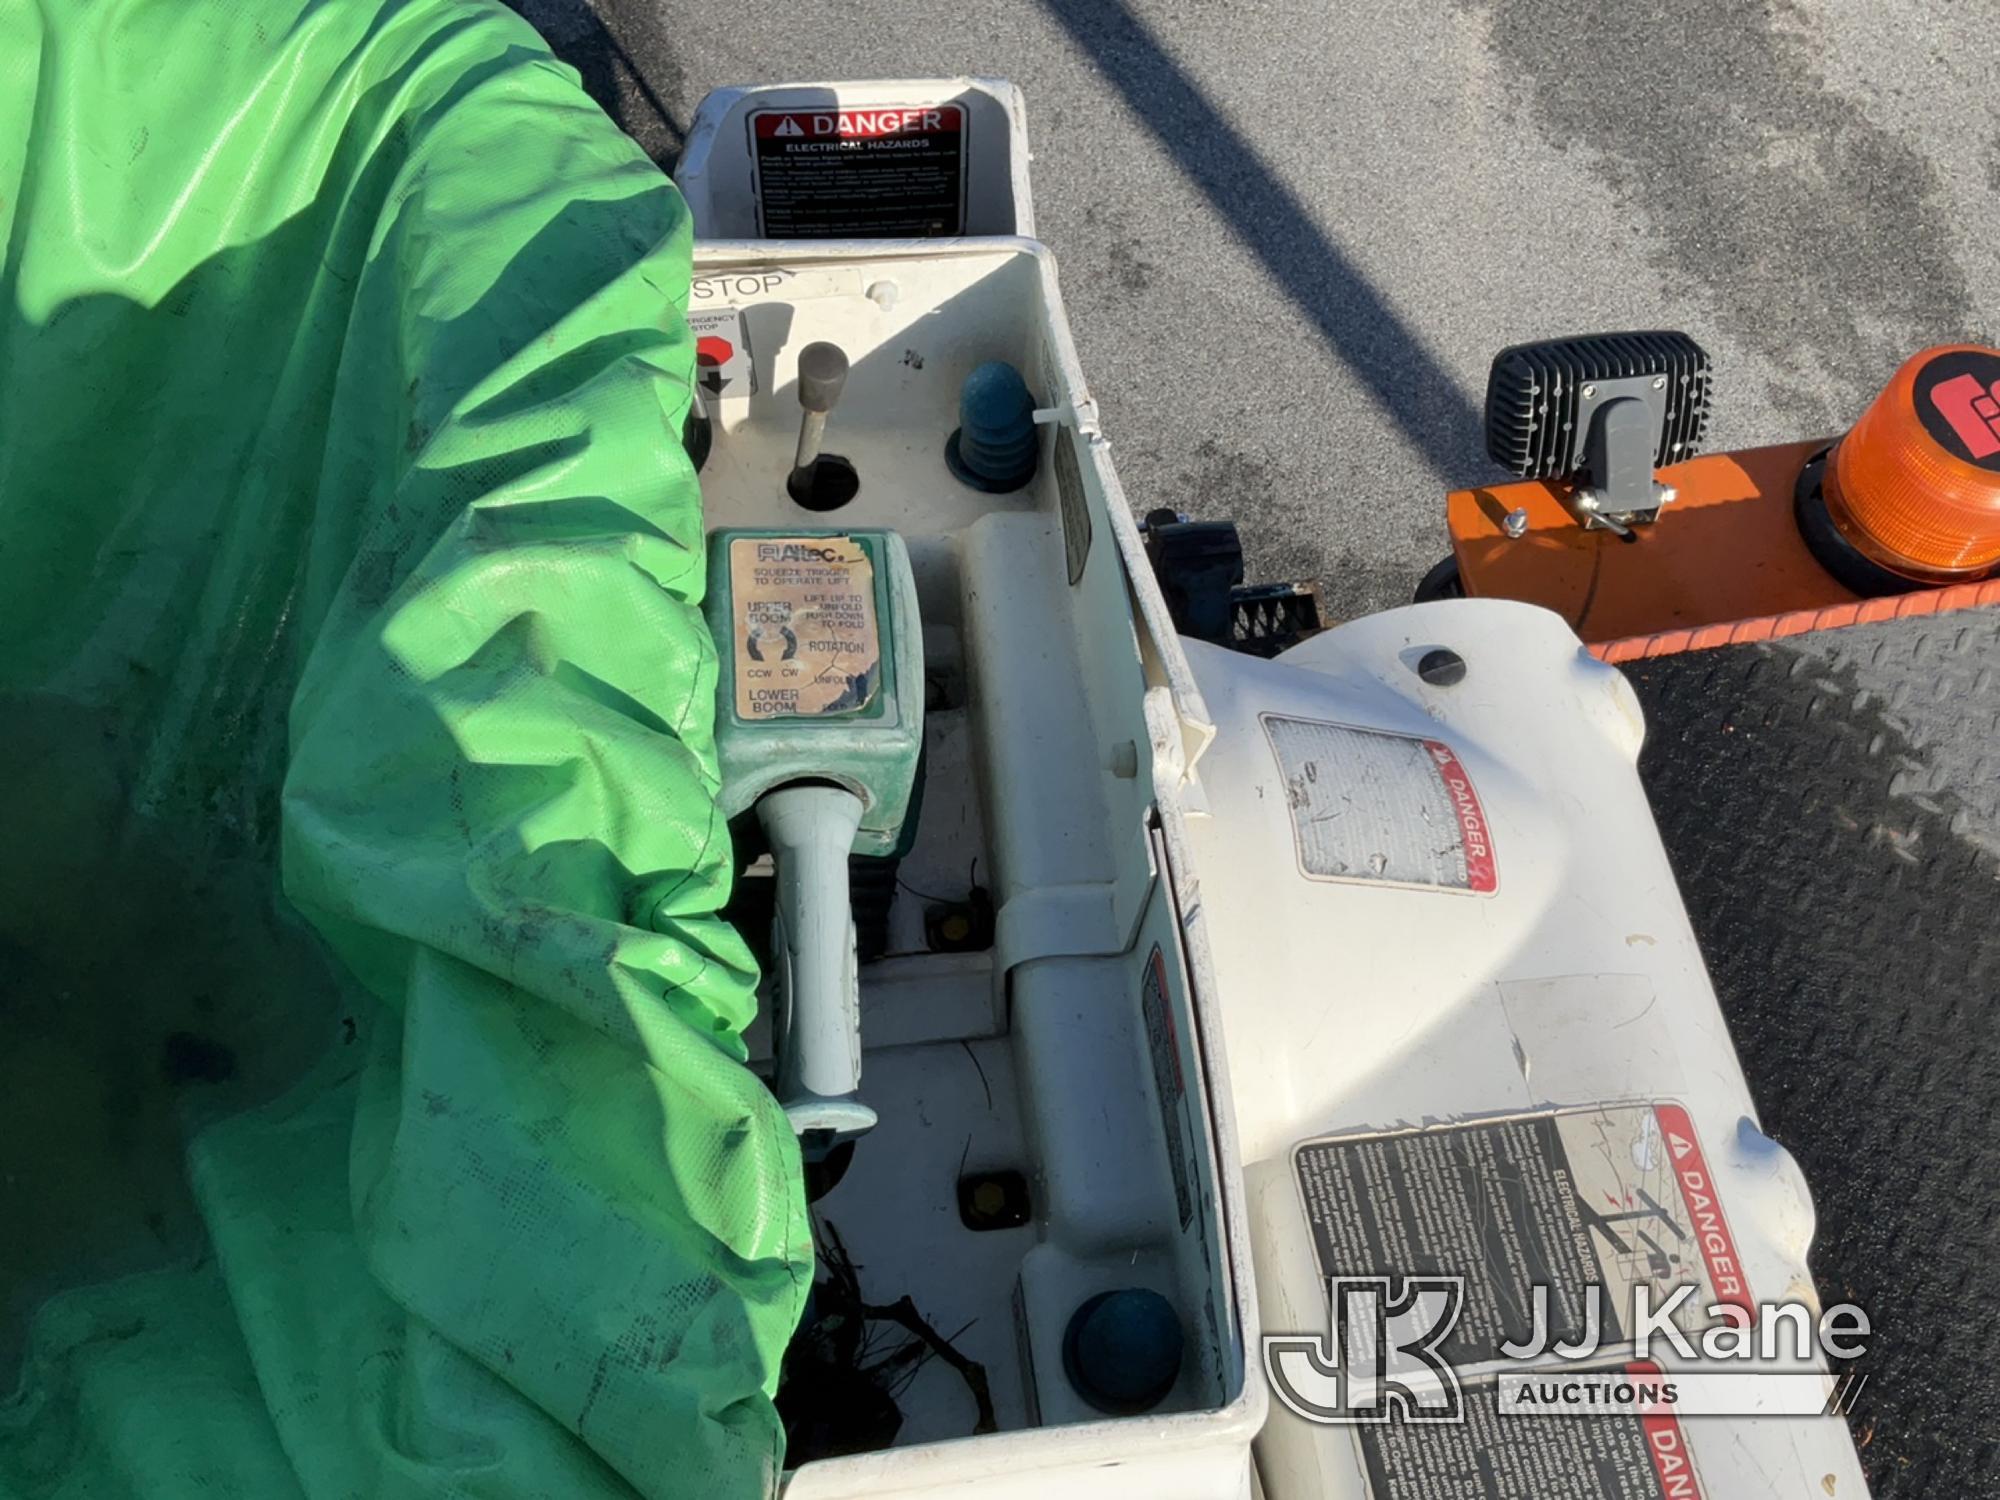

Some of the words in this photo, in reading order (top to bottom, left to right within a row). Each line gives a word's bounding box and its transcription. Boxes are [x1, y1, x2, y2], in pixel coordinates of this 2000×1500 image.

[813, 110, 942, 135] DANGER
[786, 142, 865, 153] ELECTRICAL
[867, 138, 930, 150] HAZARDS
[693, 275, 782, 299] STOP
[686, 314, 735, 325] ERGENCY
[691, 324, 719, 332] STOP
[754, 568, 801, 578] SQUEEZE
[806, 568, 850, 577] TRIGGER
[754, 577, 769, 585] TO
[773, 577, 823, 585] OPERATE
[828, 577, 850, 585] LIFT
[747, 602, 793, 612] UPPER
[748, 613, 792, 624] BOOM
[836, 612, 864, 620] DOWN
[821, 620, 835, 628] TO
[838, 620, 865, 629] FOLD
[809, 641, 865, 653] ROTATION
[747, 669, 773, 678] CCW
[781, 668, 799, 677] CW
[748, 689, 799, 700] LOWER
[752, 701, 797, 713] BOOM
[1449, 778, 1486, 858] DANGER
[1551, 1168, 1583, 1231] ELECTRICAL
[1571, 1232, 1599, 1283] HAZARDS
[1680, 1169, 1742, 1296] DANGER
[1469, 1392, 1495, 1446] protection
[1479, 1391, 1506, 1443] Personnel
[1498, 1416, 1515, 1441] each
[1386, 1436, 1399, 1448] to
[1524, 1430, 1537, 1443] all
[1573, 1419, 1588, 1445] must
[1582, 1446, 1595, 1461] be
[1587, 1422, 1611, 1462] injury.
[1407, 1436, 1424, 1464] move
[1420, 1441, 1440, 1473] under
[1426, 1432, 1450, 1472] operate
[1485, 1447, 1500, 1468] and
[1496, 1445, 1513, 1472] must
[1517, 1443, 1530, 1456] all
[1533, 1430, 1558, 1478] extended
[1549, 1480, 1561, 1492] to
[1555, 1433, 1572, 1459] prior
[1565, 1462, 1576, 1473] to
[1610, 1448, 1626, 1471] will
[1614, 1431, 1635, 1462] obey
[1626, 1464, 1642, 1485] the
[1403, 1460, 1417, 1478] are
[1450, 1438, 1471, 1475] charts.
[1462, 1479, 1476, 1495] Do
[1459, 1432, 1480, 1470] exceed
[1470, 1472, 1486, 1493] unit
[1504, 1442, 1530, 1496] operation.
[1526, 1444, 1550, 1488] controls
[1629, 1433, 1660, 1497] OPERATING
[1649, 1429, 1695, 1500] DAN
[1491, 1469, 1509, 1498] other
[1503, 1473, 1518, 1494] use
